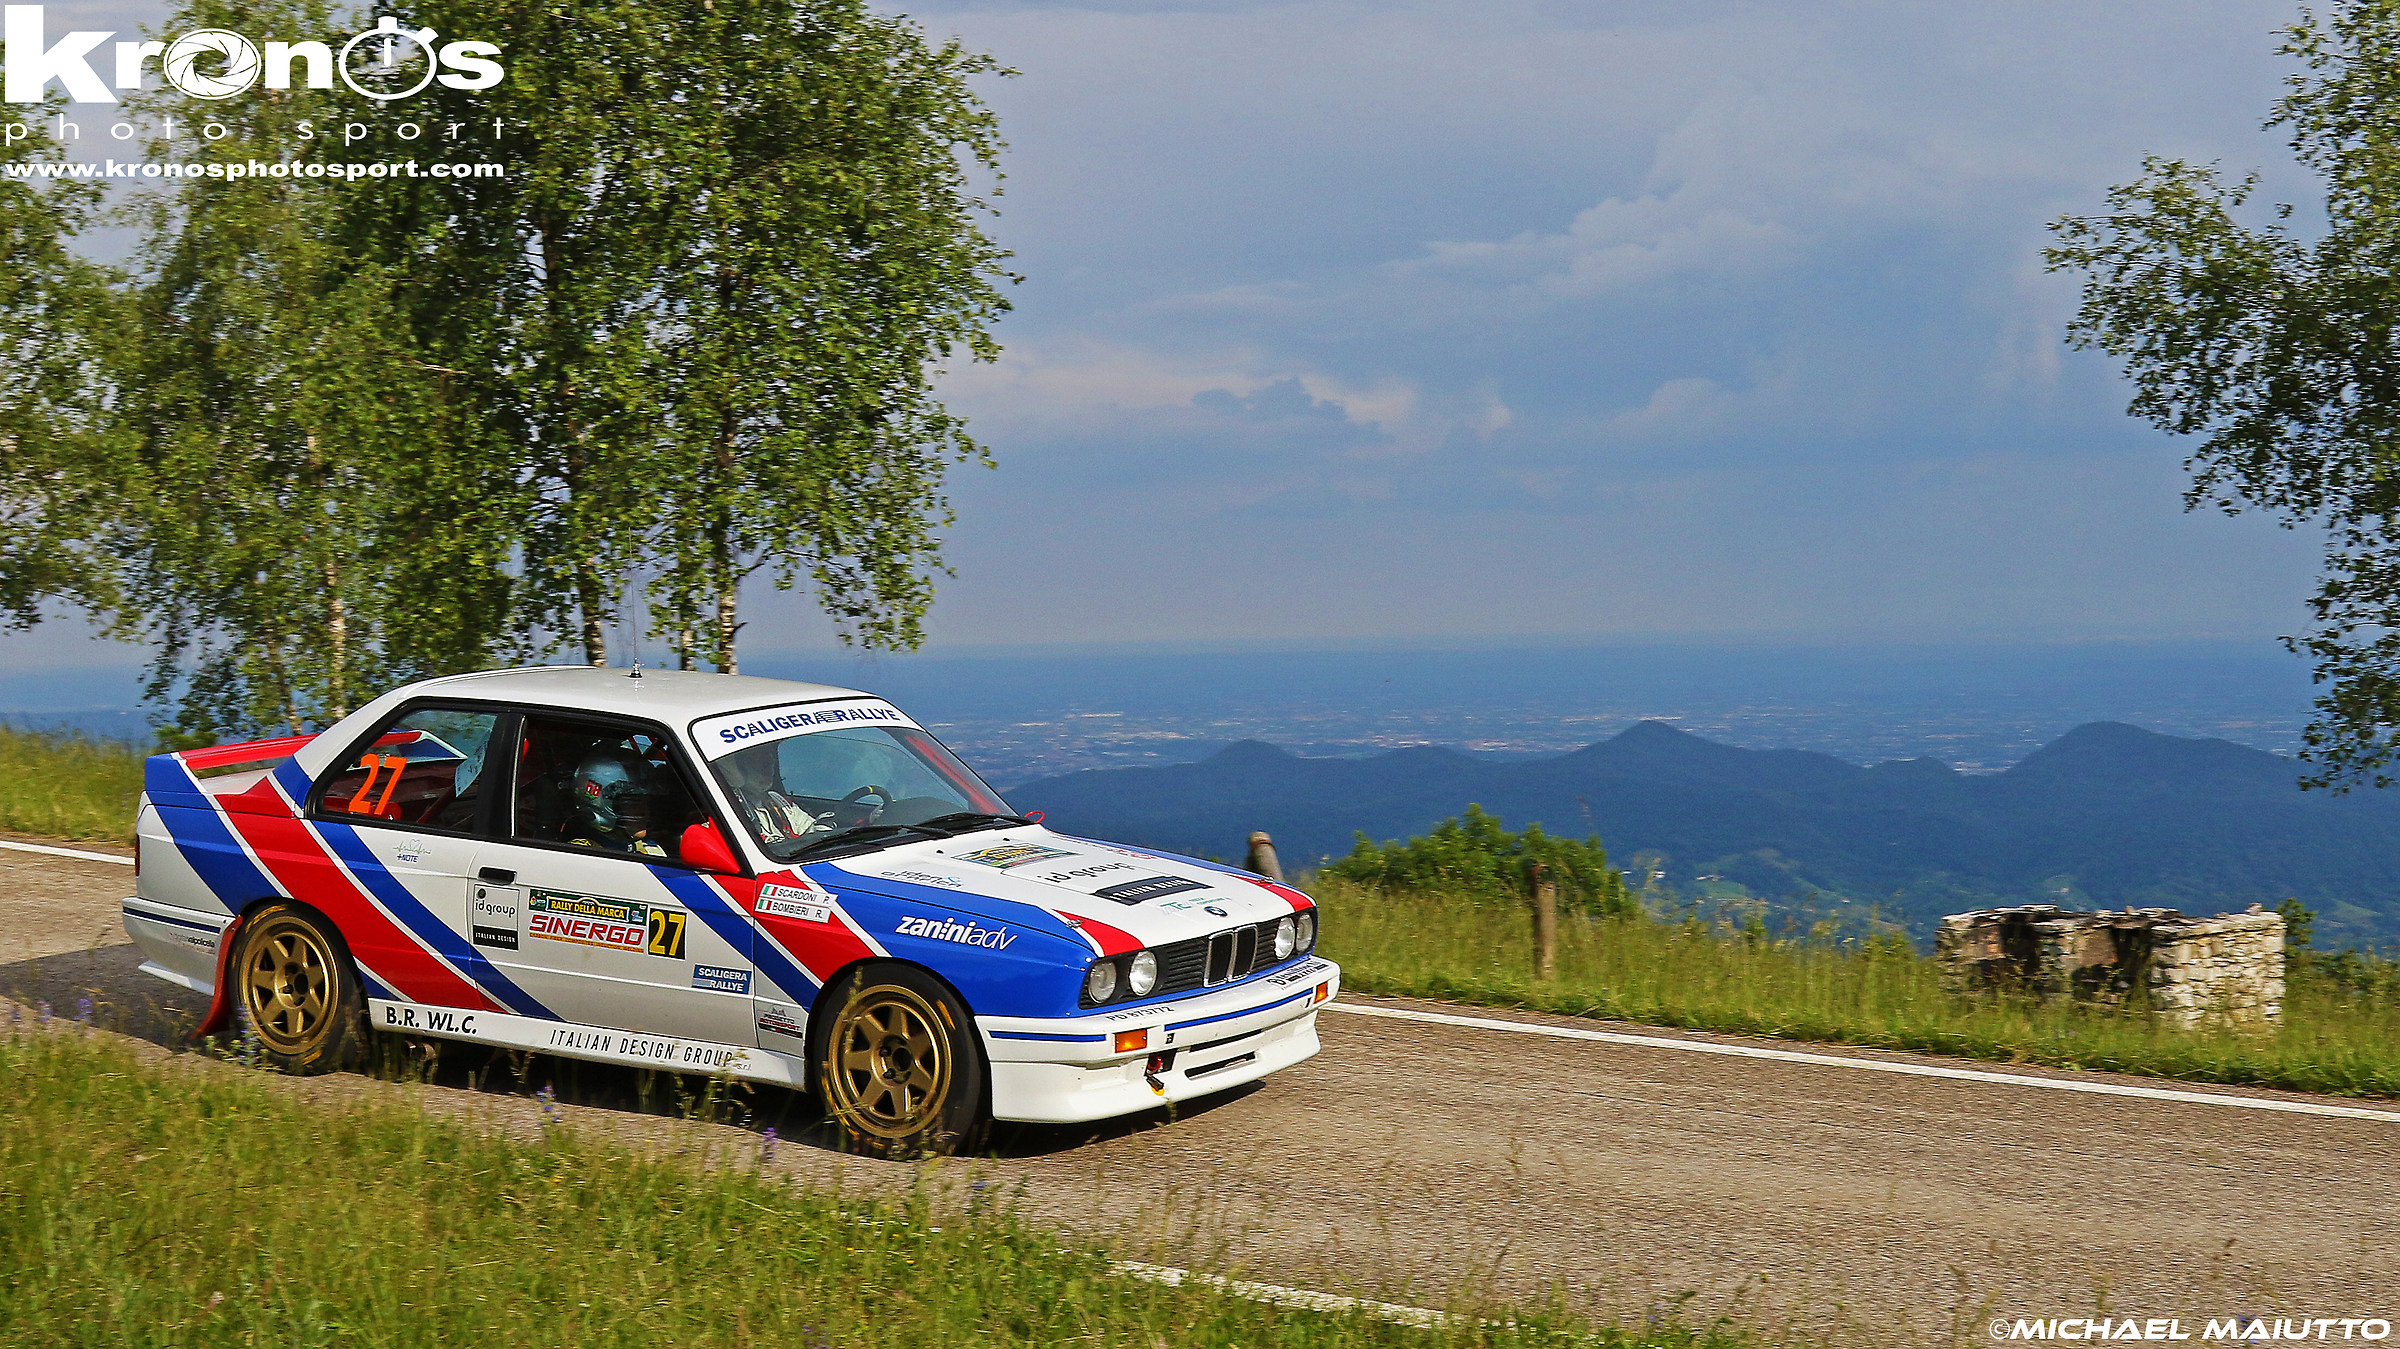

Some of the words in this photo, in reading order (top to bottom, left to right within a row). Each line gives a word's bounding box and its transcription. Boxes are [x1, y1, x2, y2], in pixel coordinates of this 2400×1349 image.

[720, 711, 825, 744] SCALIGERA
[835, 708, 900, 722] RALLYE
[348, 753, 408, 815] 27
[777, 889, 818, 902] SCARDONI
[486, 904, 516, 918] group
[551, 901, 573, 911] RALLY
[574, 904, 596, 914] DELLA
[597, 907, 625, 918] MARCA
[772, 902, 810, 916] BOMBIERI
[530, 915, 644, 945] SINERGO
[649, 911, 685, 956] 27
[698, 968, 748, 981] SCALIGERA
[709, 980, 744, 992] RALLYE
[386, 1006, 420, 1028] B.R.
[550, 1029, 612, 1052] ITALIAN
[619, 1038, 675, 1060] DESIGN
[684, 1046, 733, 1067] GROUP
